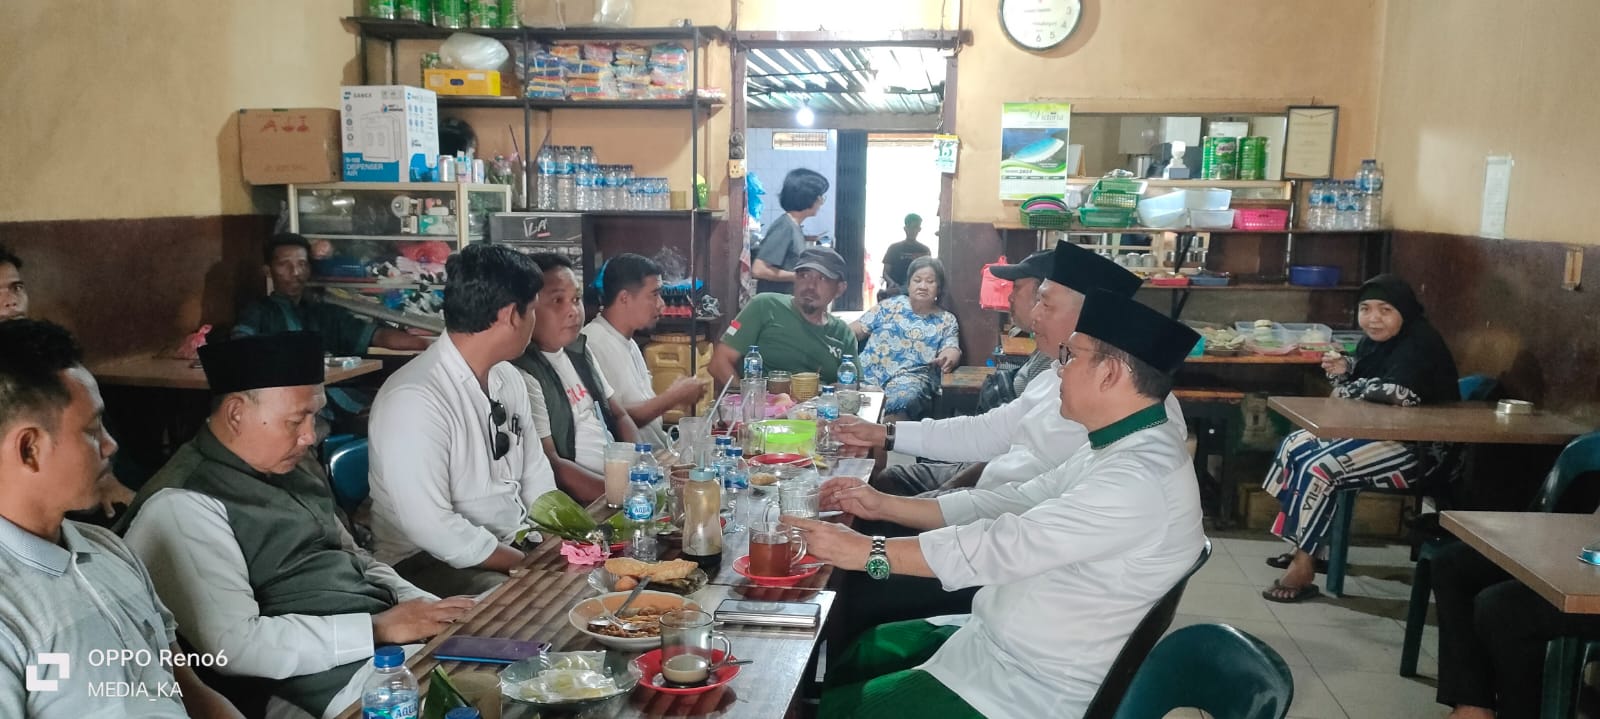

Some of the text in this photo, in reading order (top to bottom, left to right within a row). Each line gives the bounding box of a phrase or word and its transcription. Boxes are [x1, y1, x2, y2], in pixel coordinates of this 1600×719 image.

[1066, 6, 1072, 15] 3
[1061, 20, 1067, 28] 4
[1036, 34, 1042, 42] 6
[1049, 31, 1055, 39] 5
[1303, 483, 1321, 511] FILA
[633, 505, 651, 514] AQUA
[395, 701, 418, 718] AQUA
